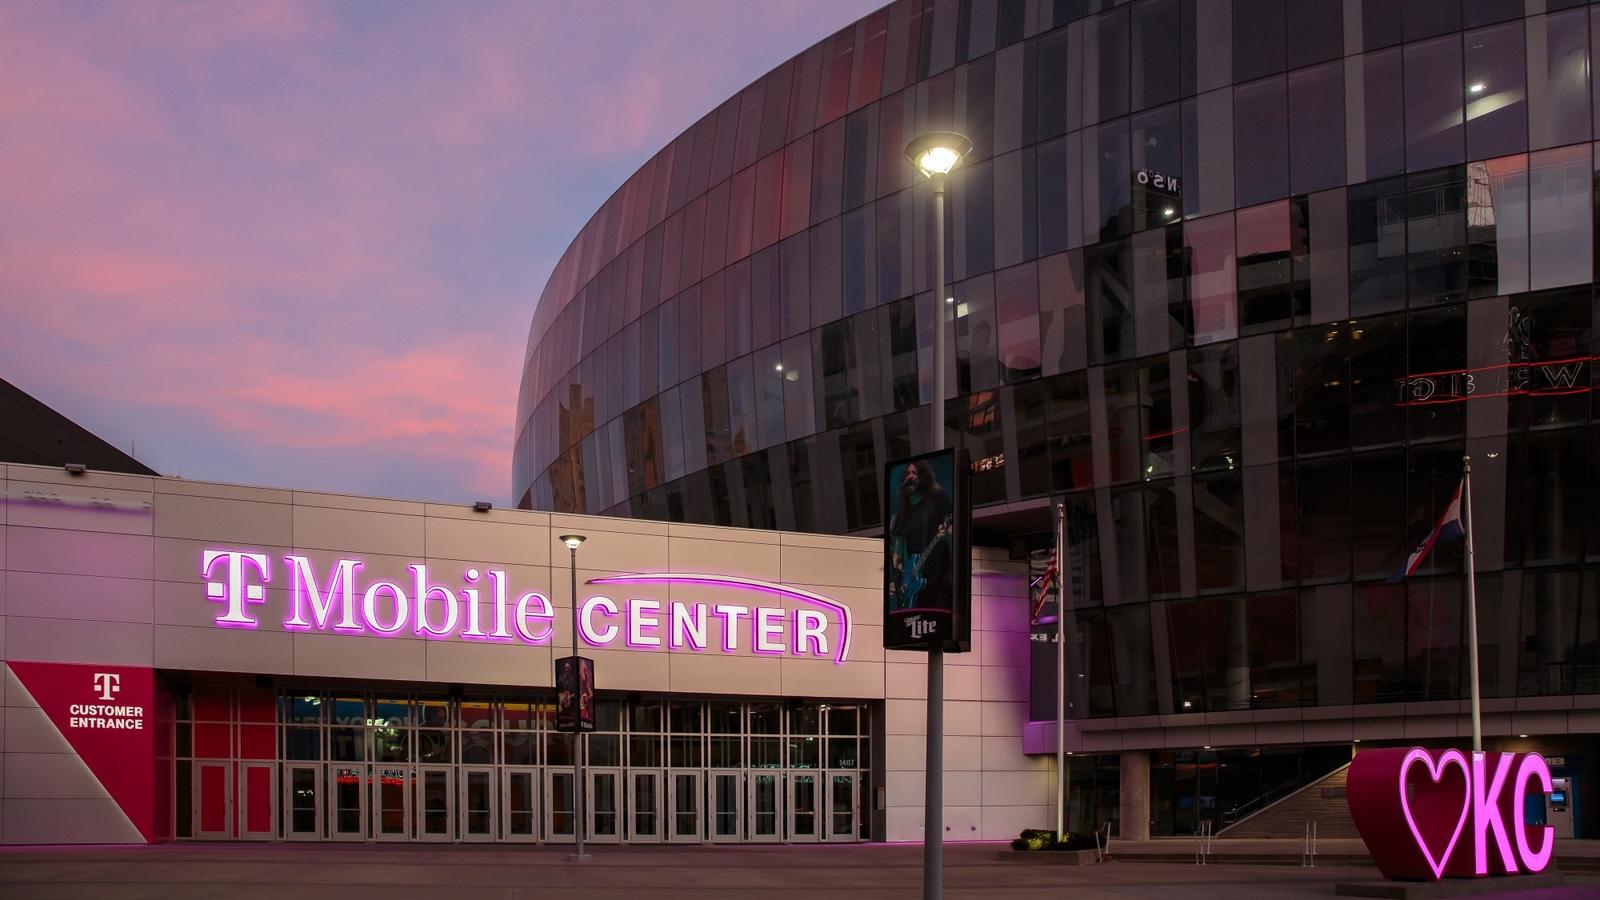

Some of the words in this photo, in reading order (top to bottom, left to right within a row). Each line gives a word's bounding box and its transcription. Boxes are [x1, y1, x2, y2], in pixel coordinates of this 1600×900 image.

[284, 555, 555, 641] Mobile
[578, 596, 829, 655] CENTER
[910, 619, 937, 639] Lite
[69, 704, 144, 717] CUSTOMER
[69, 717, 144, 730] ENTRANCE
[839, 759, 855, 767] 1407
[1472, 751, 1554, 874] KC
